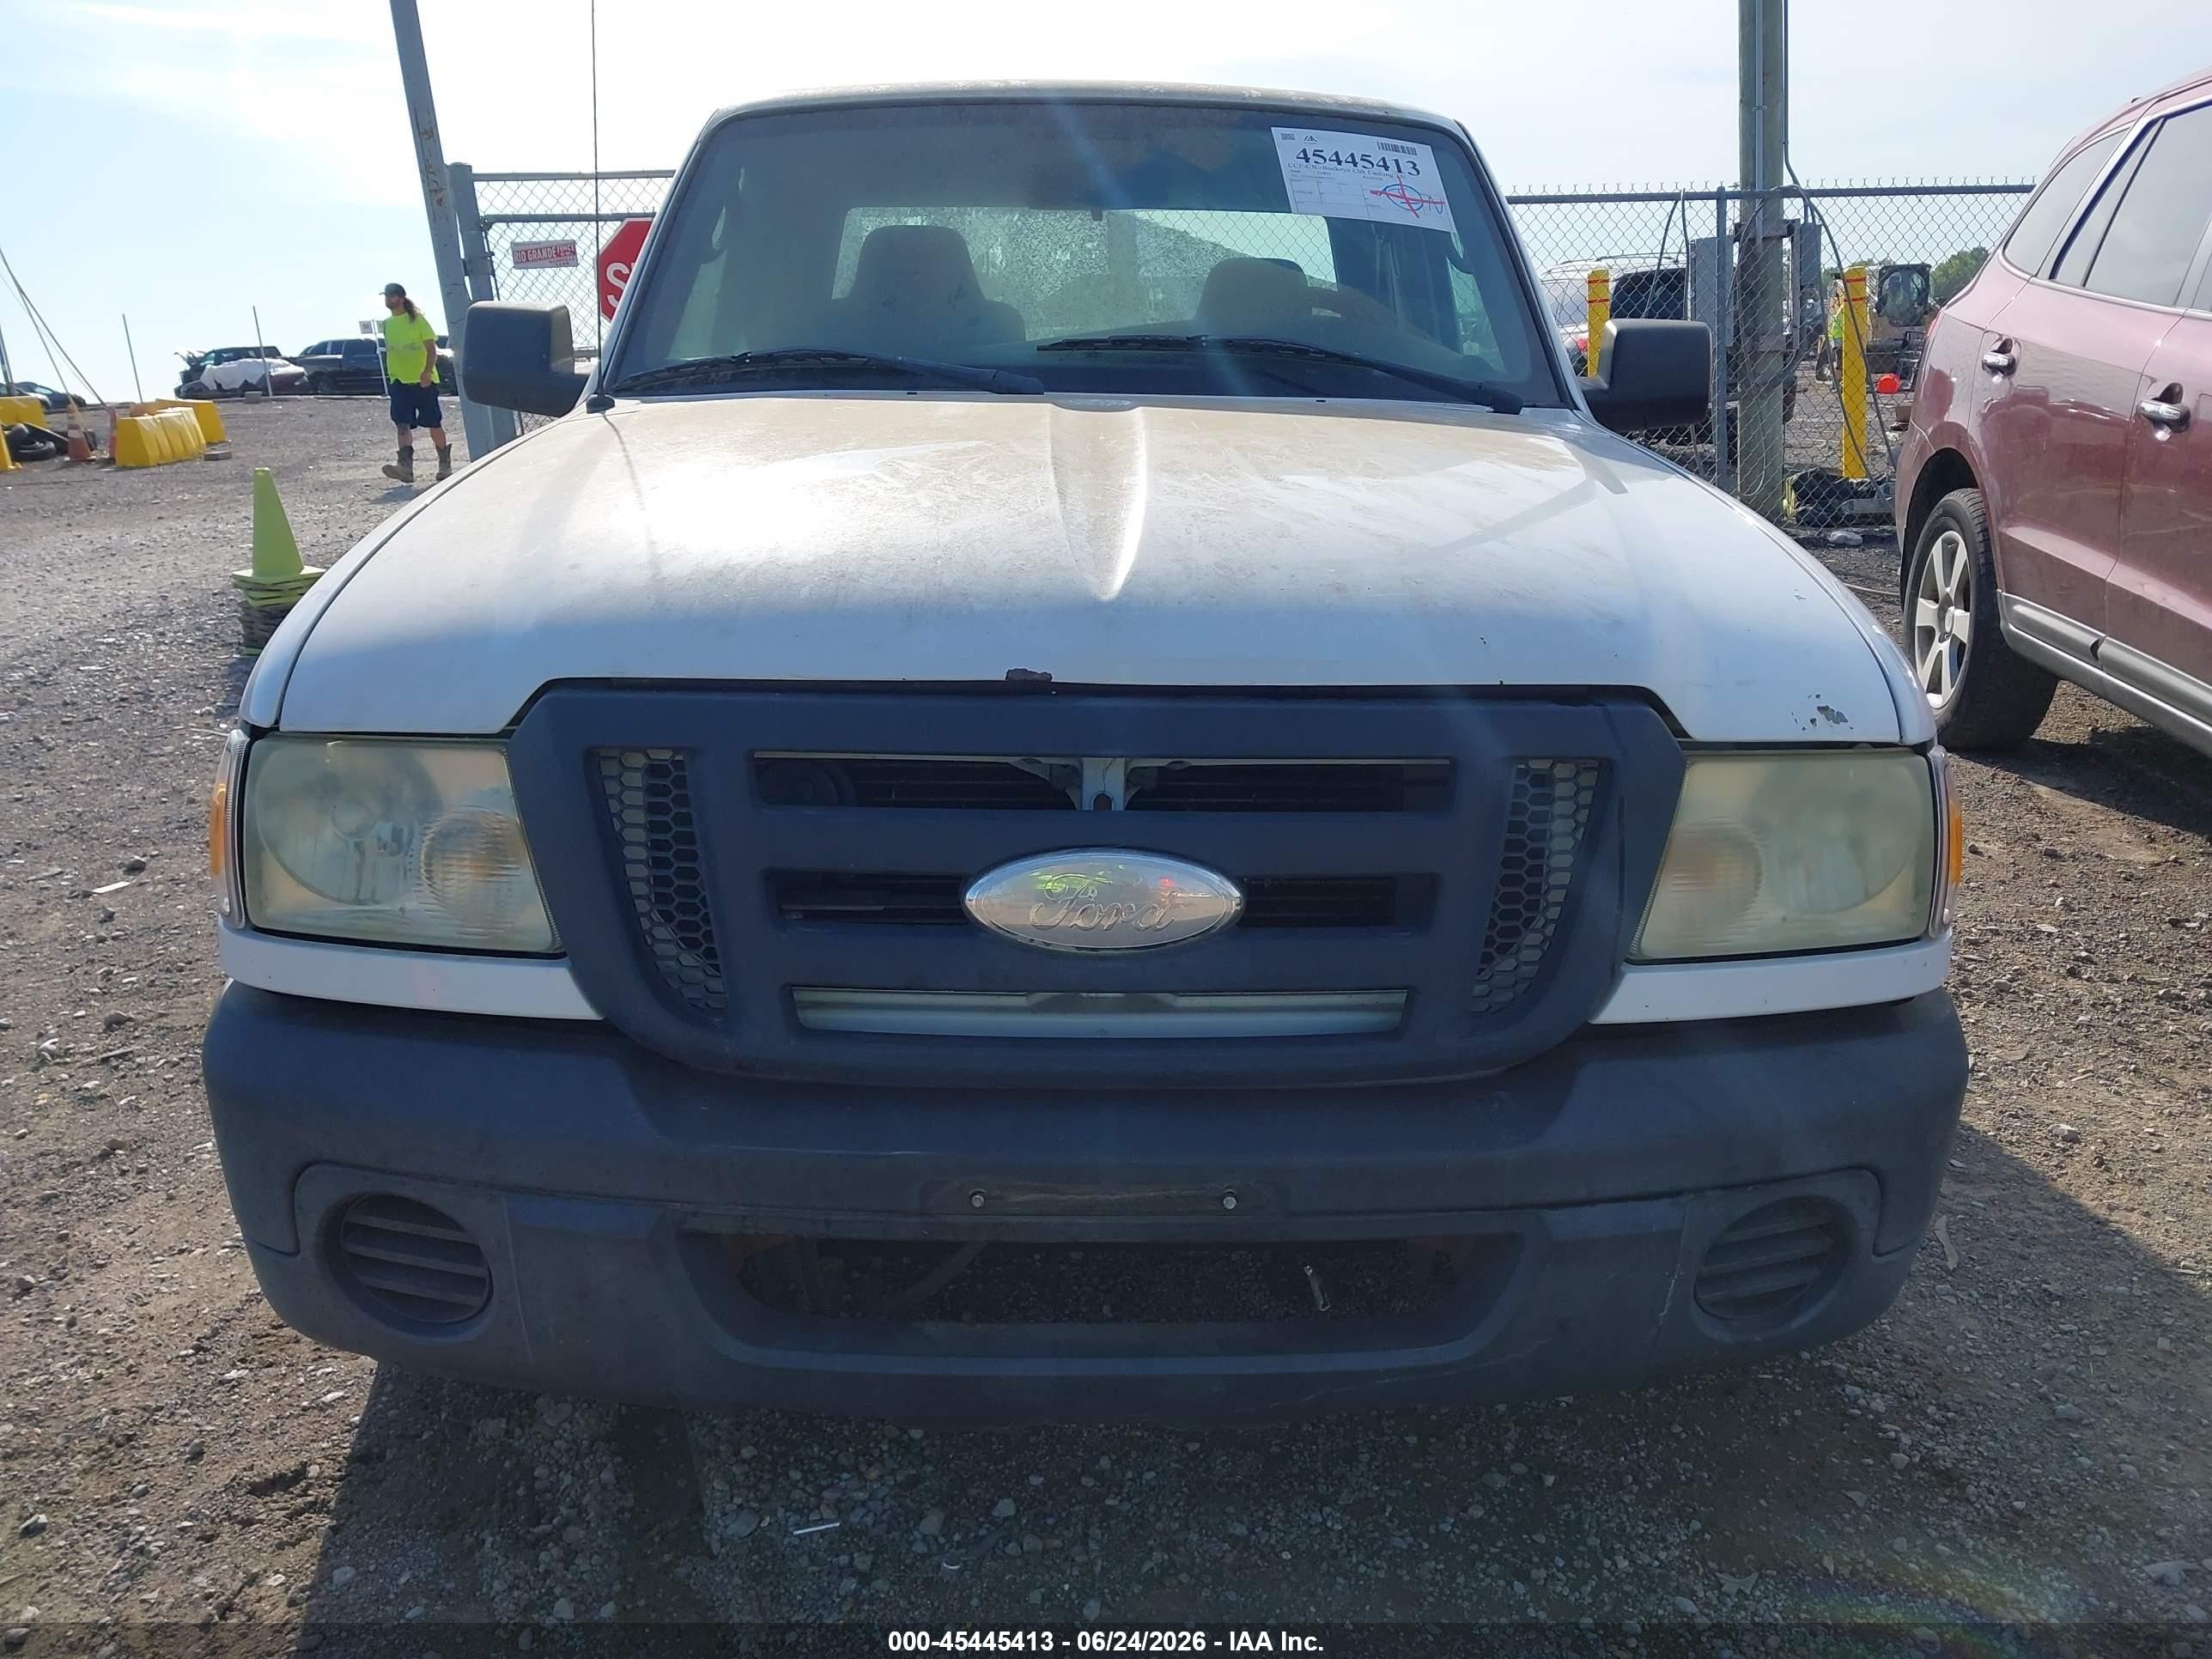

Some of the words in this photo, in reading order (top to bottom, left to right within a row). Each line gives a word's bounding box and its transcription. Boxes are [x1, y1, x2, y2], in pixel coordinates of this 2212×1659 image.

[1296, 148, 1421, 177] 45445413
[514, 251, 526, 262] RIO
[527, 246, 557, 261] GRANDE
[1029, 872, 1176, 931] Ford
